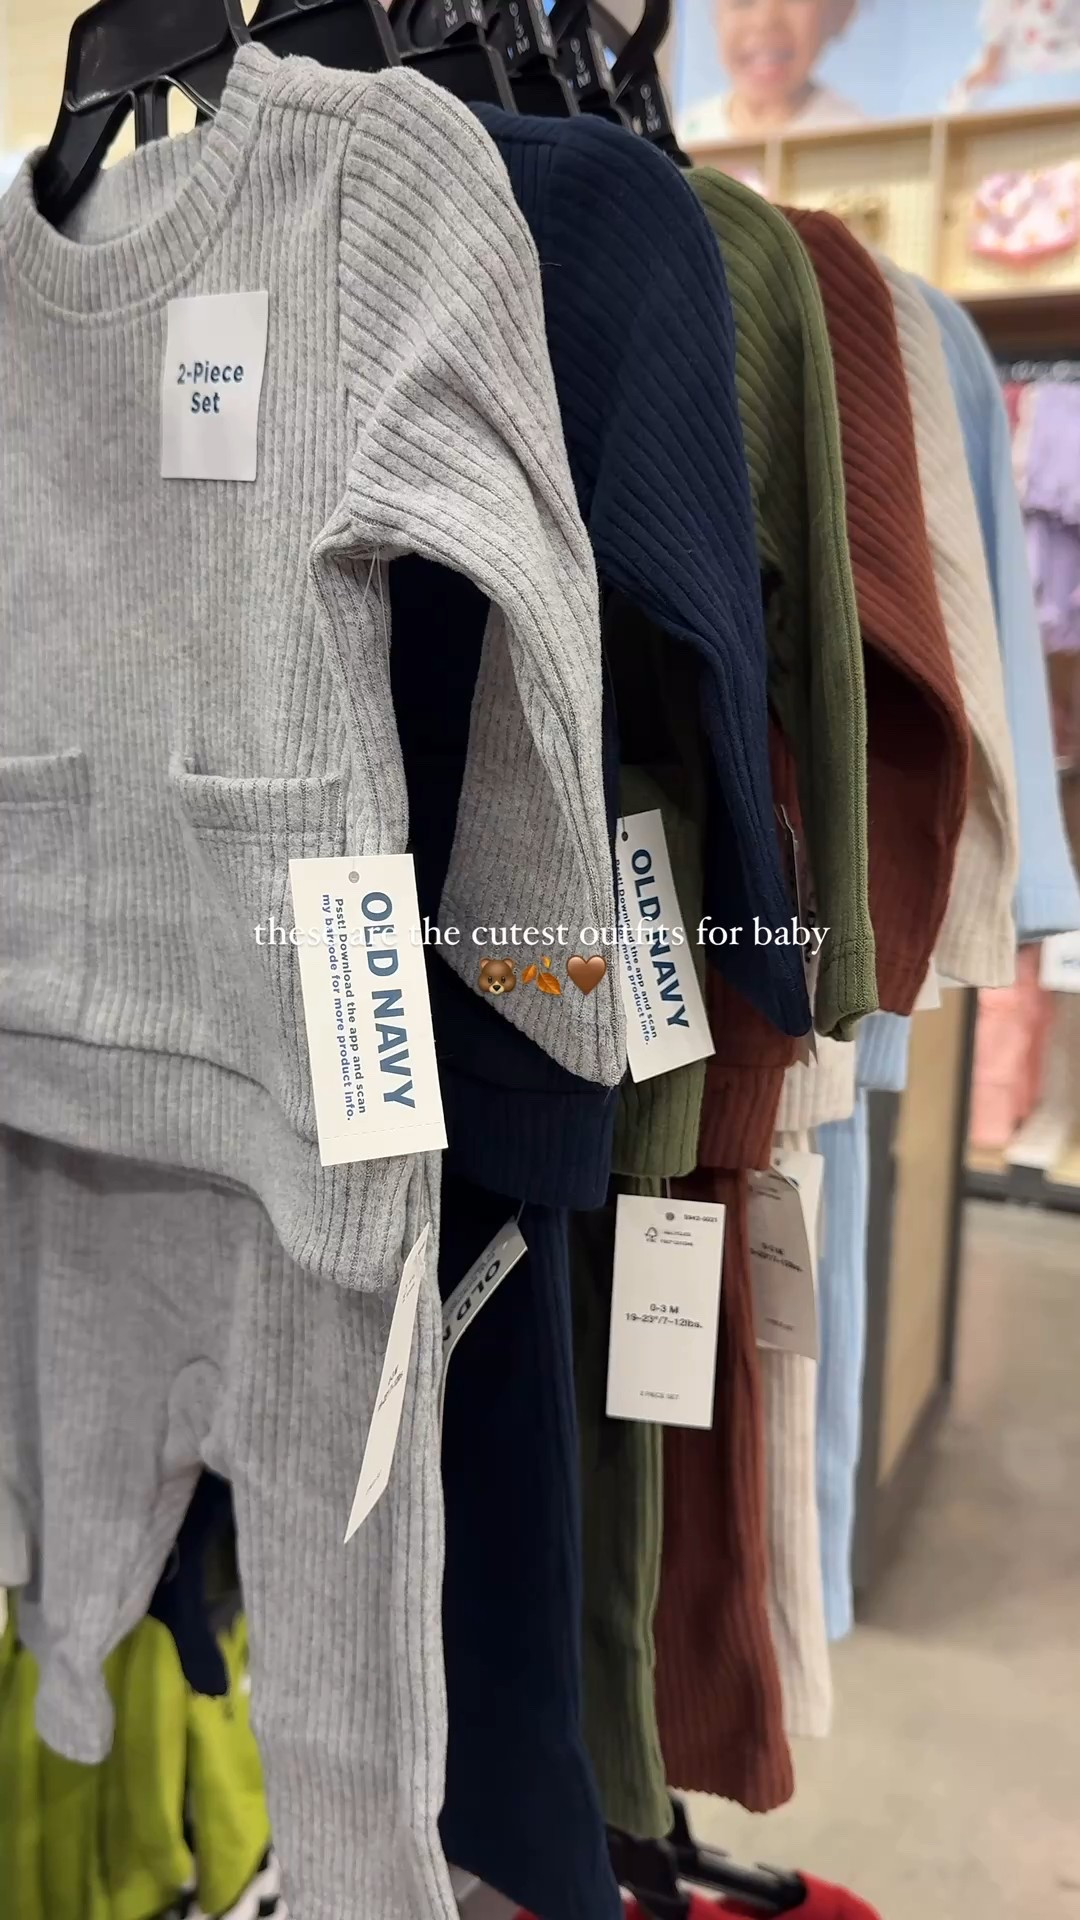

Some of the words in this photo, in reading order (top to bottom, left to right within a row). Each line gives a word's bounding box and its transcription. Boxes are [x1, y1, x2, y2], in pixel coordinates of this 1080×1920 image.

[177, 361, 244, 385] 2-Piece
[191, 392, 220, 414] Set
[631, 848, 661, 921] OLD
[322, 894, 331, 913] my
[335, 898, 347, 929] Psst!
[361, 891, 399, 977] OLD
[339, 934, 354, 998] Download
[645, 929, 690, 1028] NAVY
[332, 975, 341, 993] for
[621, 944, 633, 971] more
[628, 975, 645, 1018] product
[640, 1020, 650, 1045] info.
[630, 946, 638, 964] the
[635, 967, 645, 988] app
[641, 991, 652, 1011] and
[647, 1013, 658, 1038] scan
[334, 998, 345, 1031] more
[347, 1001, 356, 1023] the
[349, 1027, 359, 1052] app
[371, 988, 416, 1109] NAVY
[336, 1035, 353, 1087] product
[352, 1056, 364, 1080] and
[344, 1091, 356, 1121] info.
[356, 1083, 366, 1114] scan
